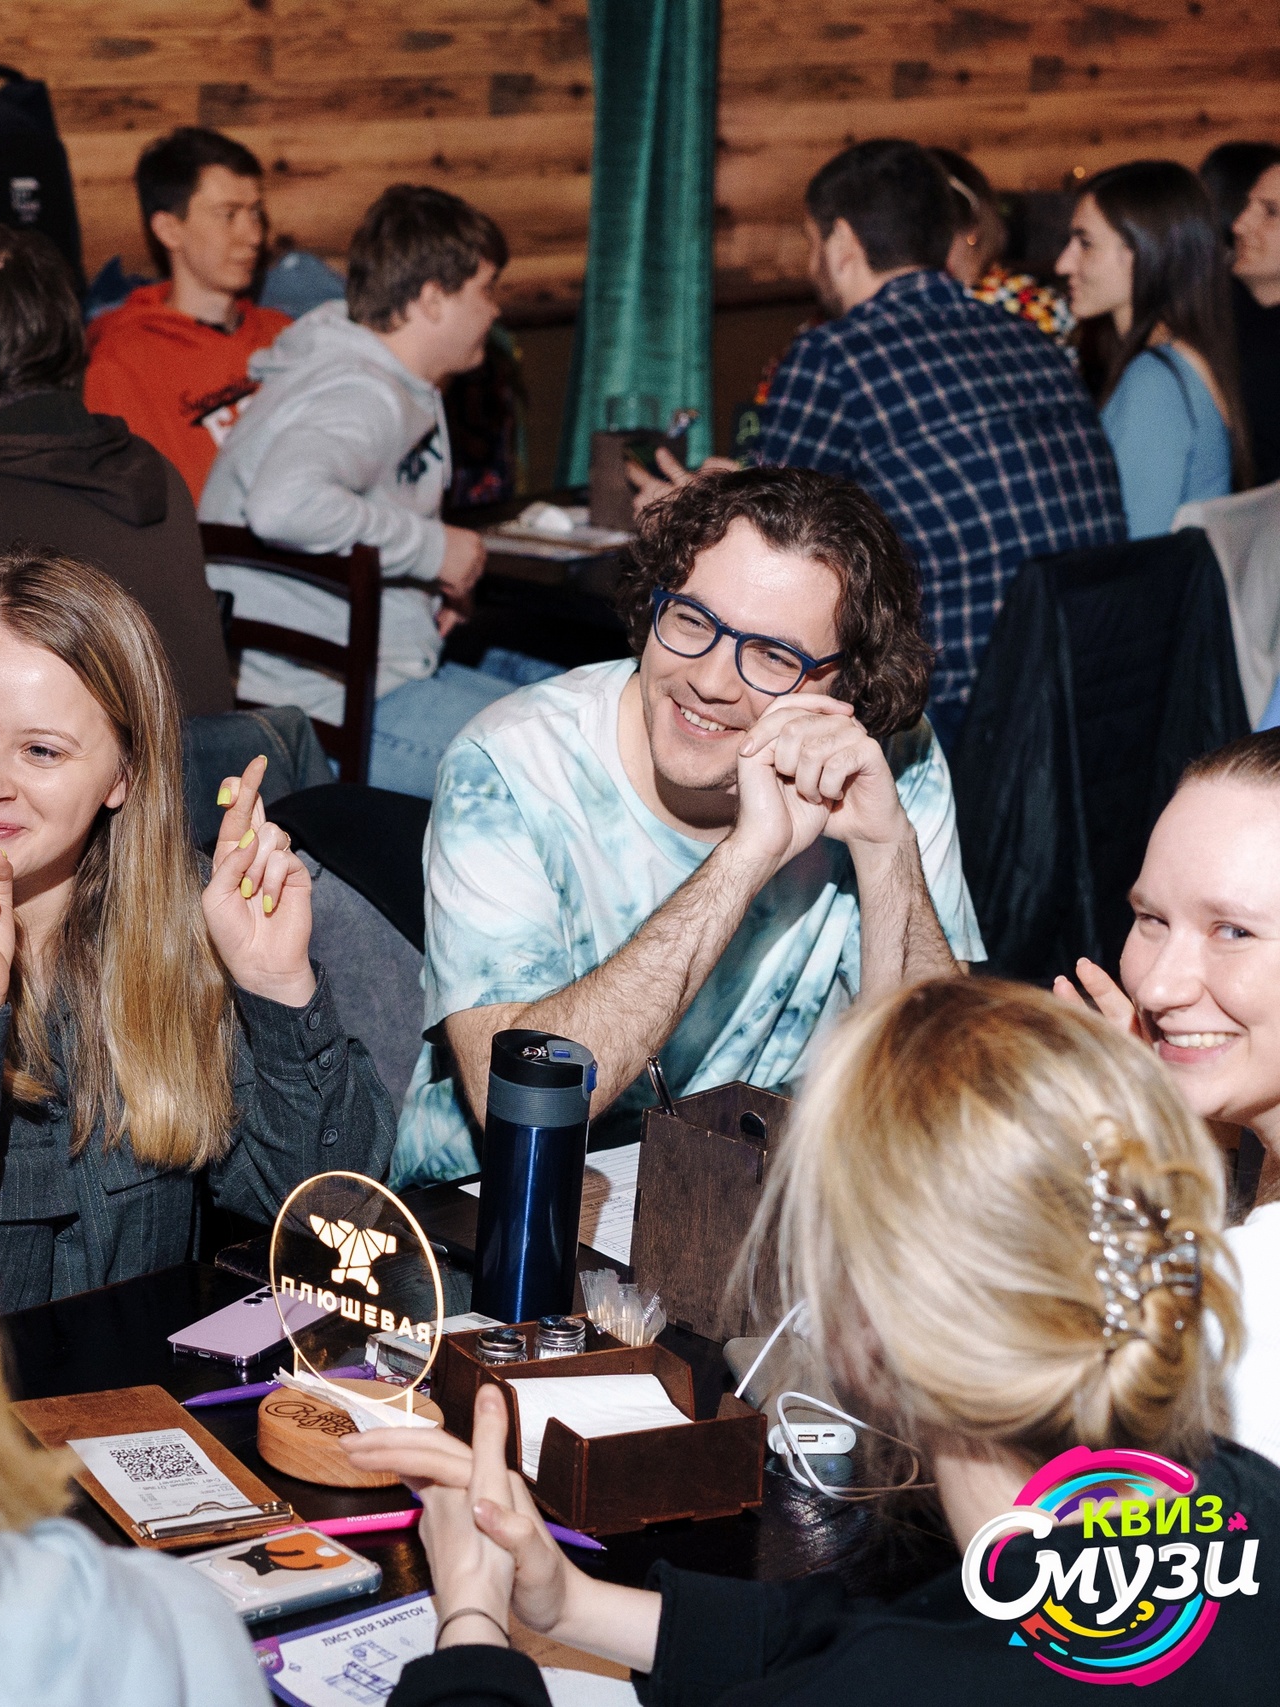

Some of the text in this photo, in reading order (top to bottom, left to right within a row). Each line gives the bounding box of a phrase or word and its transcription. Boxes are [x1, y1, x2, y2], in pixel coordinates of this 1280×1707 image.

[281, 1275, 431, 1345] ПЛЮШЕВАЯ
[322, 1605, 427, 1646] ЛИСТ ДЛЯ ЗАМЕТОК
